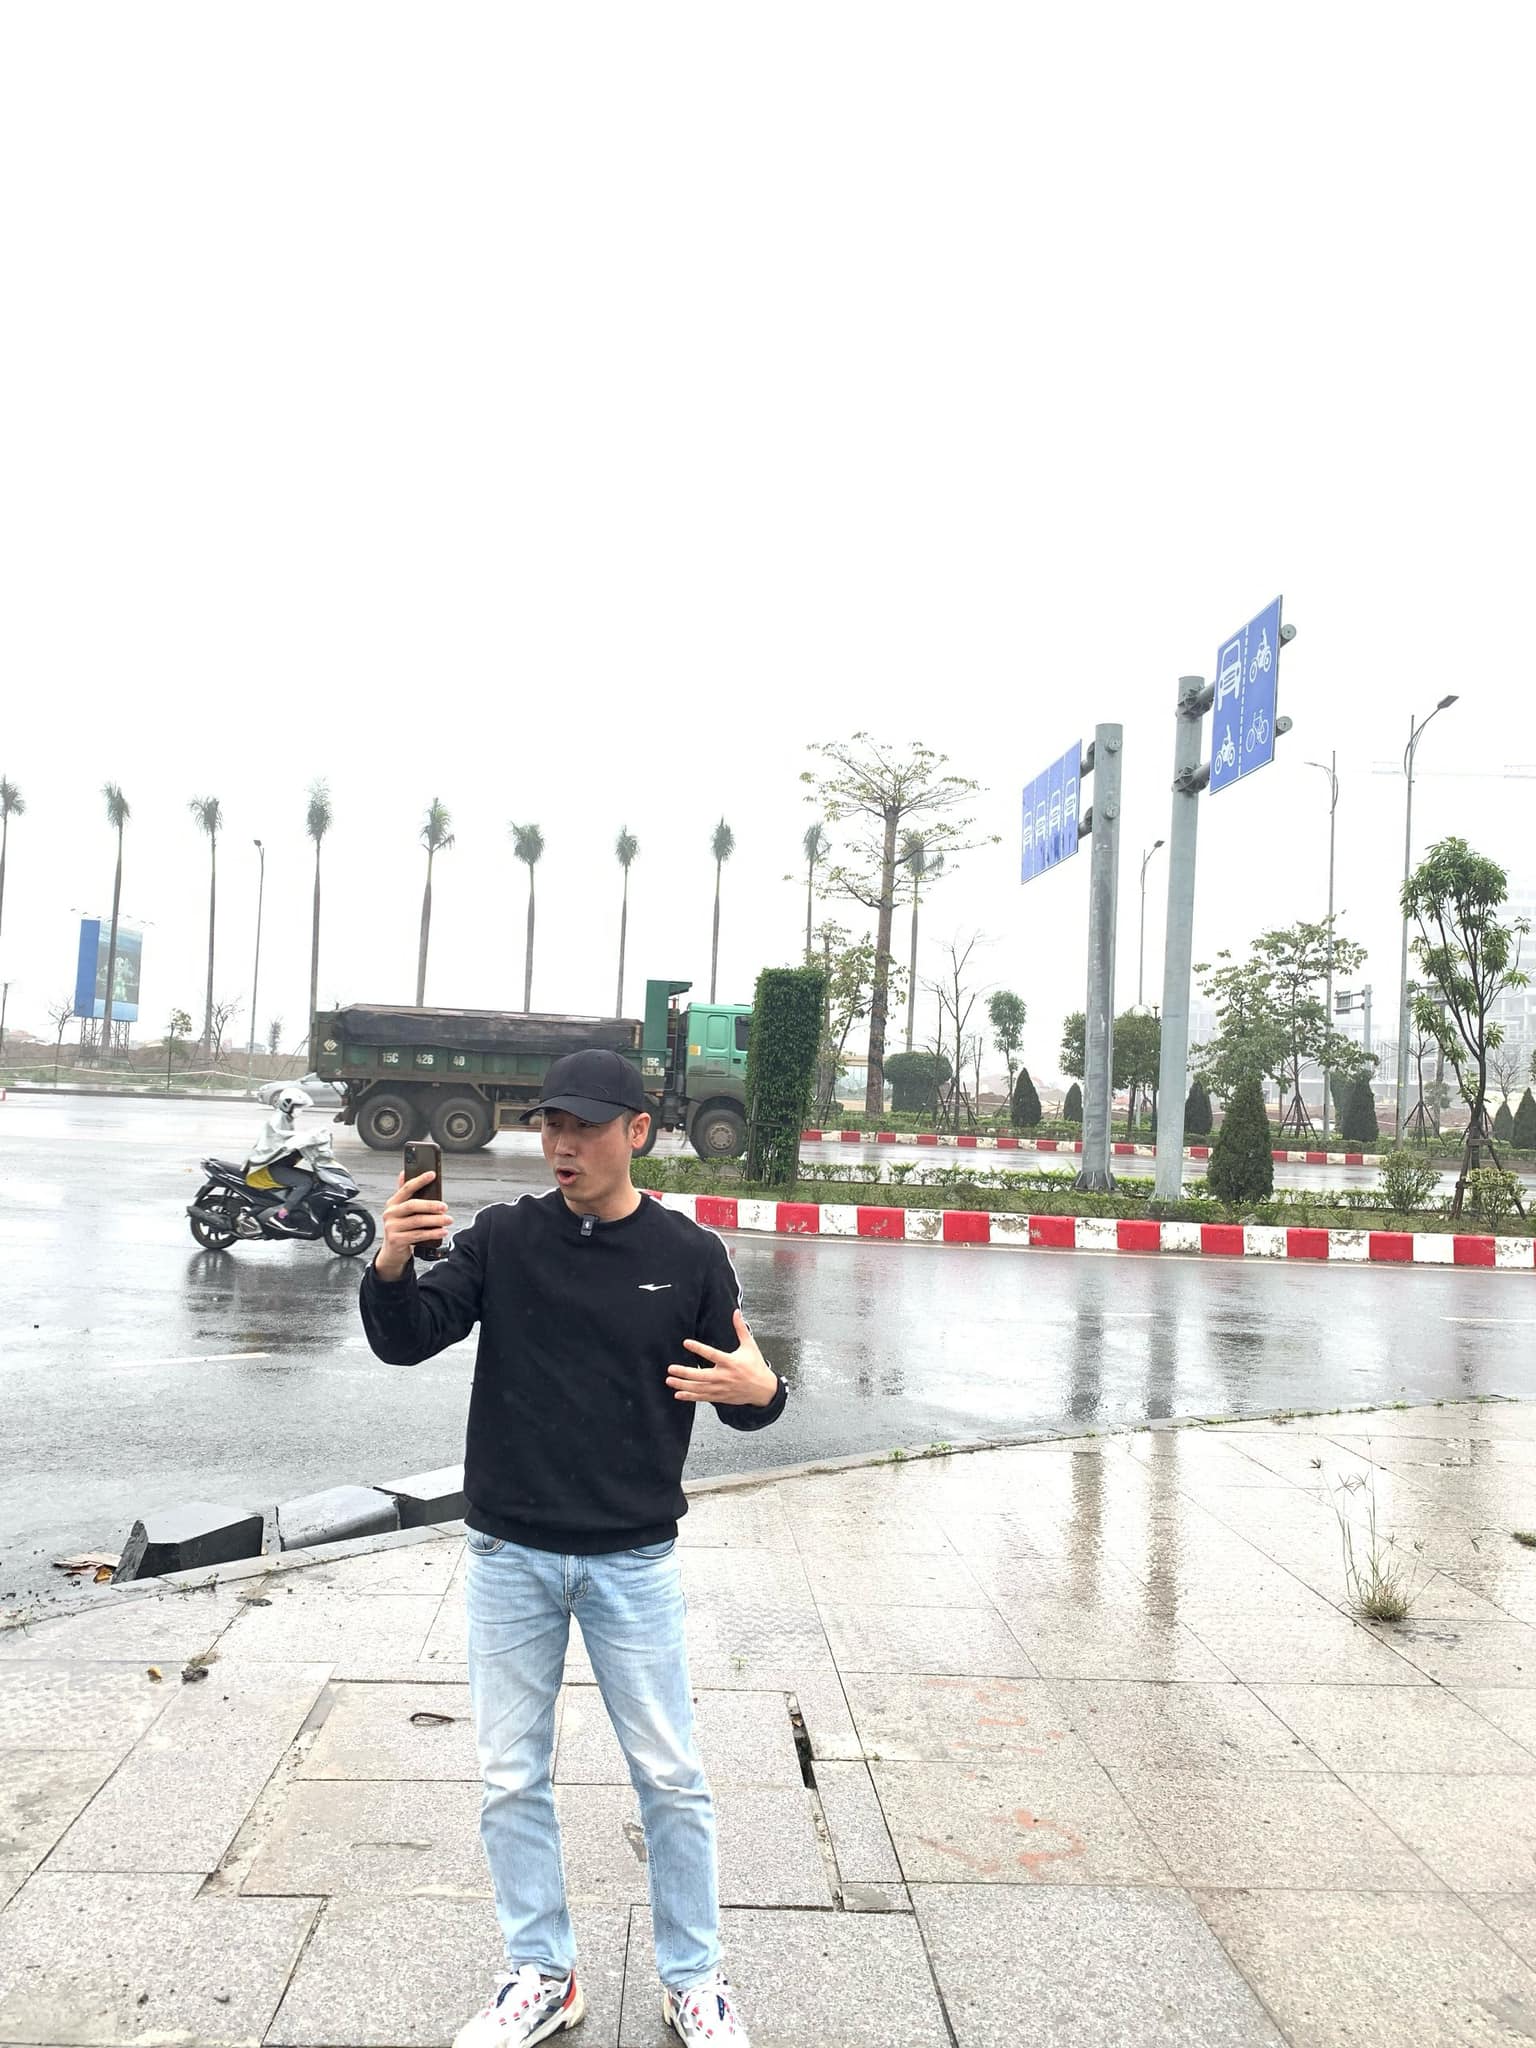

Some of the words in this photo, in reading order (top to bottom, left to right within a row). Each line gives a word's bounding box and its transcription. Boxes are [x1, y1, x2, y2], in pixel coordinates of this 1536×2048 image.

[382, 1052, 399, 1063] 15C
[416, 1054, 434, 1065] 426
[646, 1057, 660, 1067] 15C
